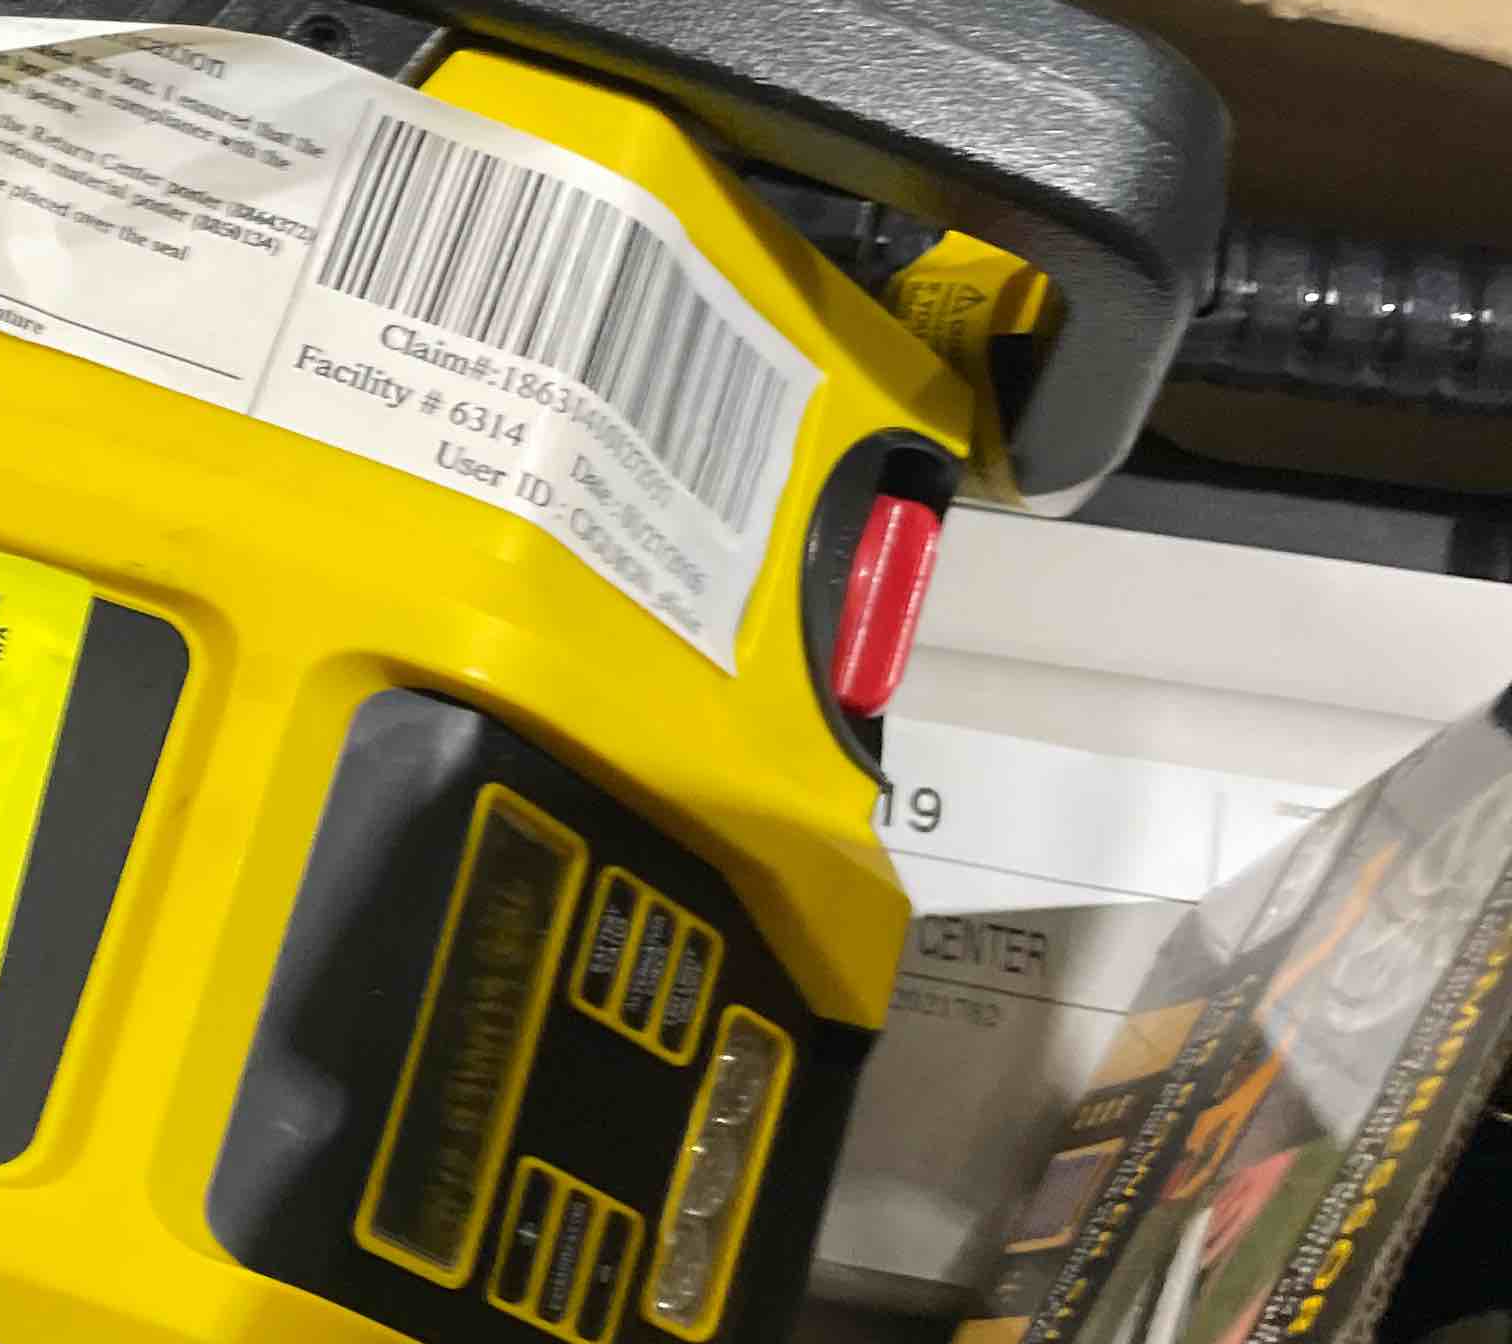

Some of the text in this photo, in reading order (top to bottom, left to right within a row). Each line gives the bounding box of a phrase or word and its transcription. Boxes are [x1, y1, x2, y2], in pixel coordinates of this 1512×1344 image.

[292, 343, 414, 409] Facility
[449, 399, 527, 448] 6314
[436, 440, 507, 489] User
